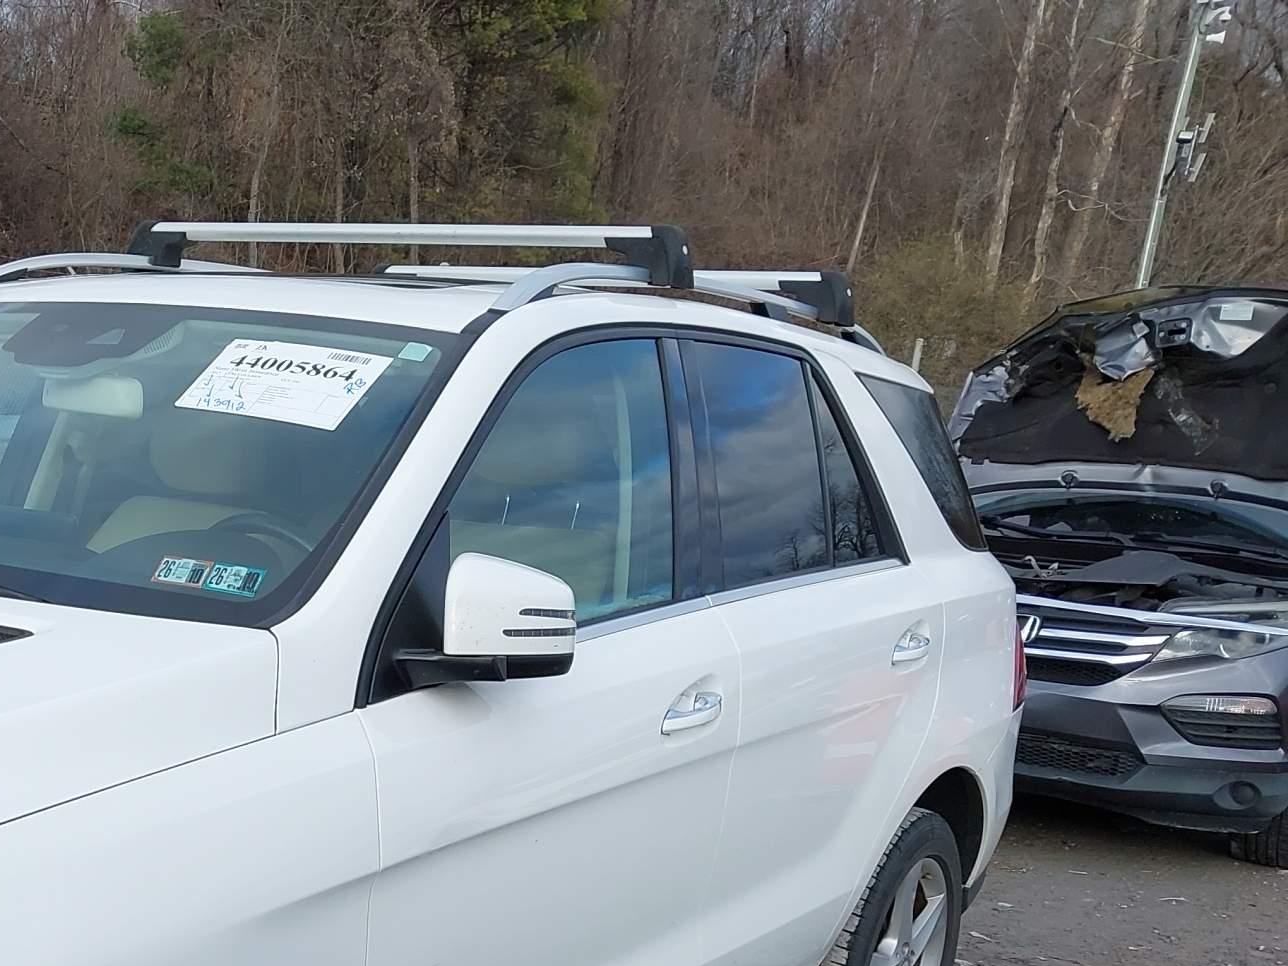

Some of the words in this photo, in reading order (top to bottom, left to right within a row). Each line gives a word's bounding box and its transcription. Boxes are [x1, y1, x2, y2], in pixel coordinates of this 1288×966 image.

[229, 354, 358, 382] 44005864
[157, 560, 176, 578] 26
[188, 567, 205, 585] 10
[209, 566, 228, 586] 26
